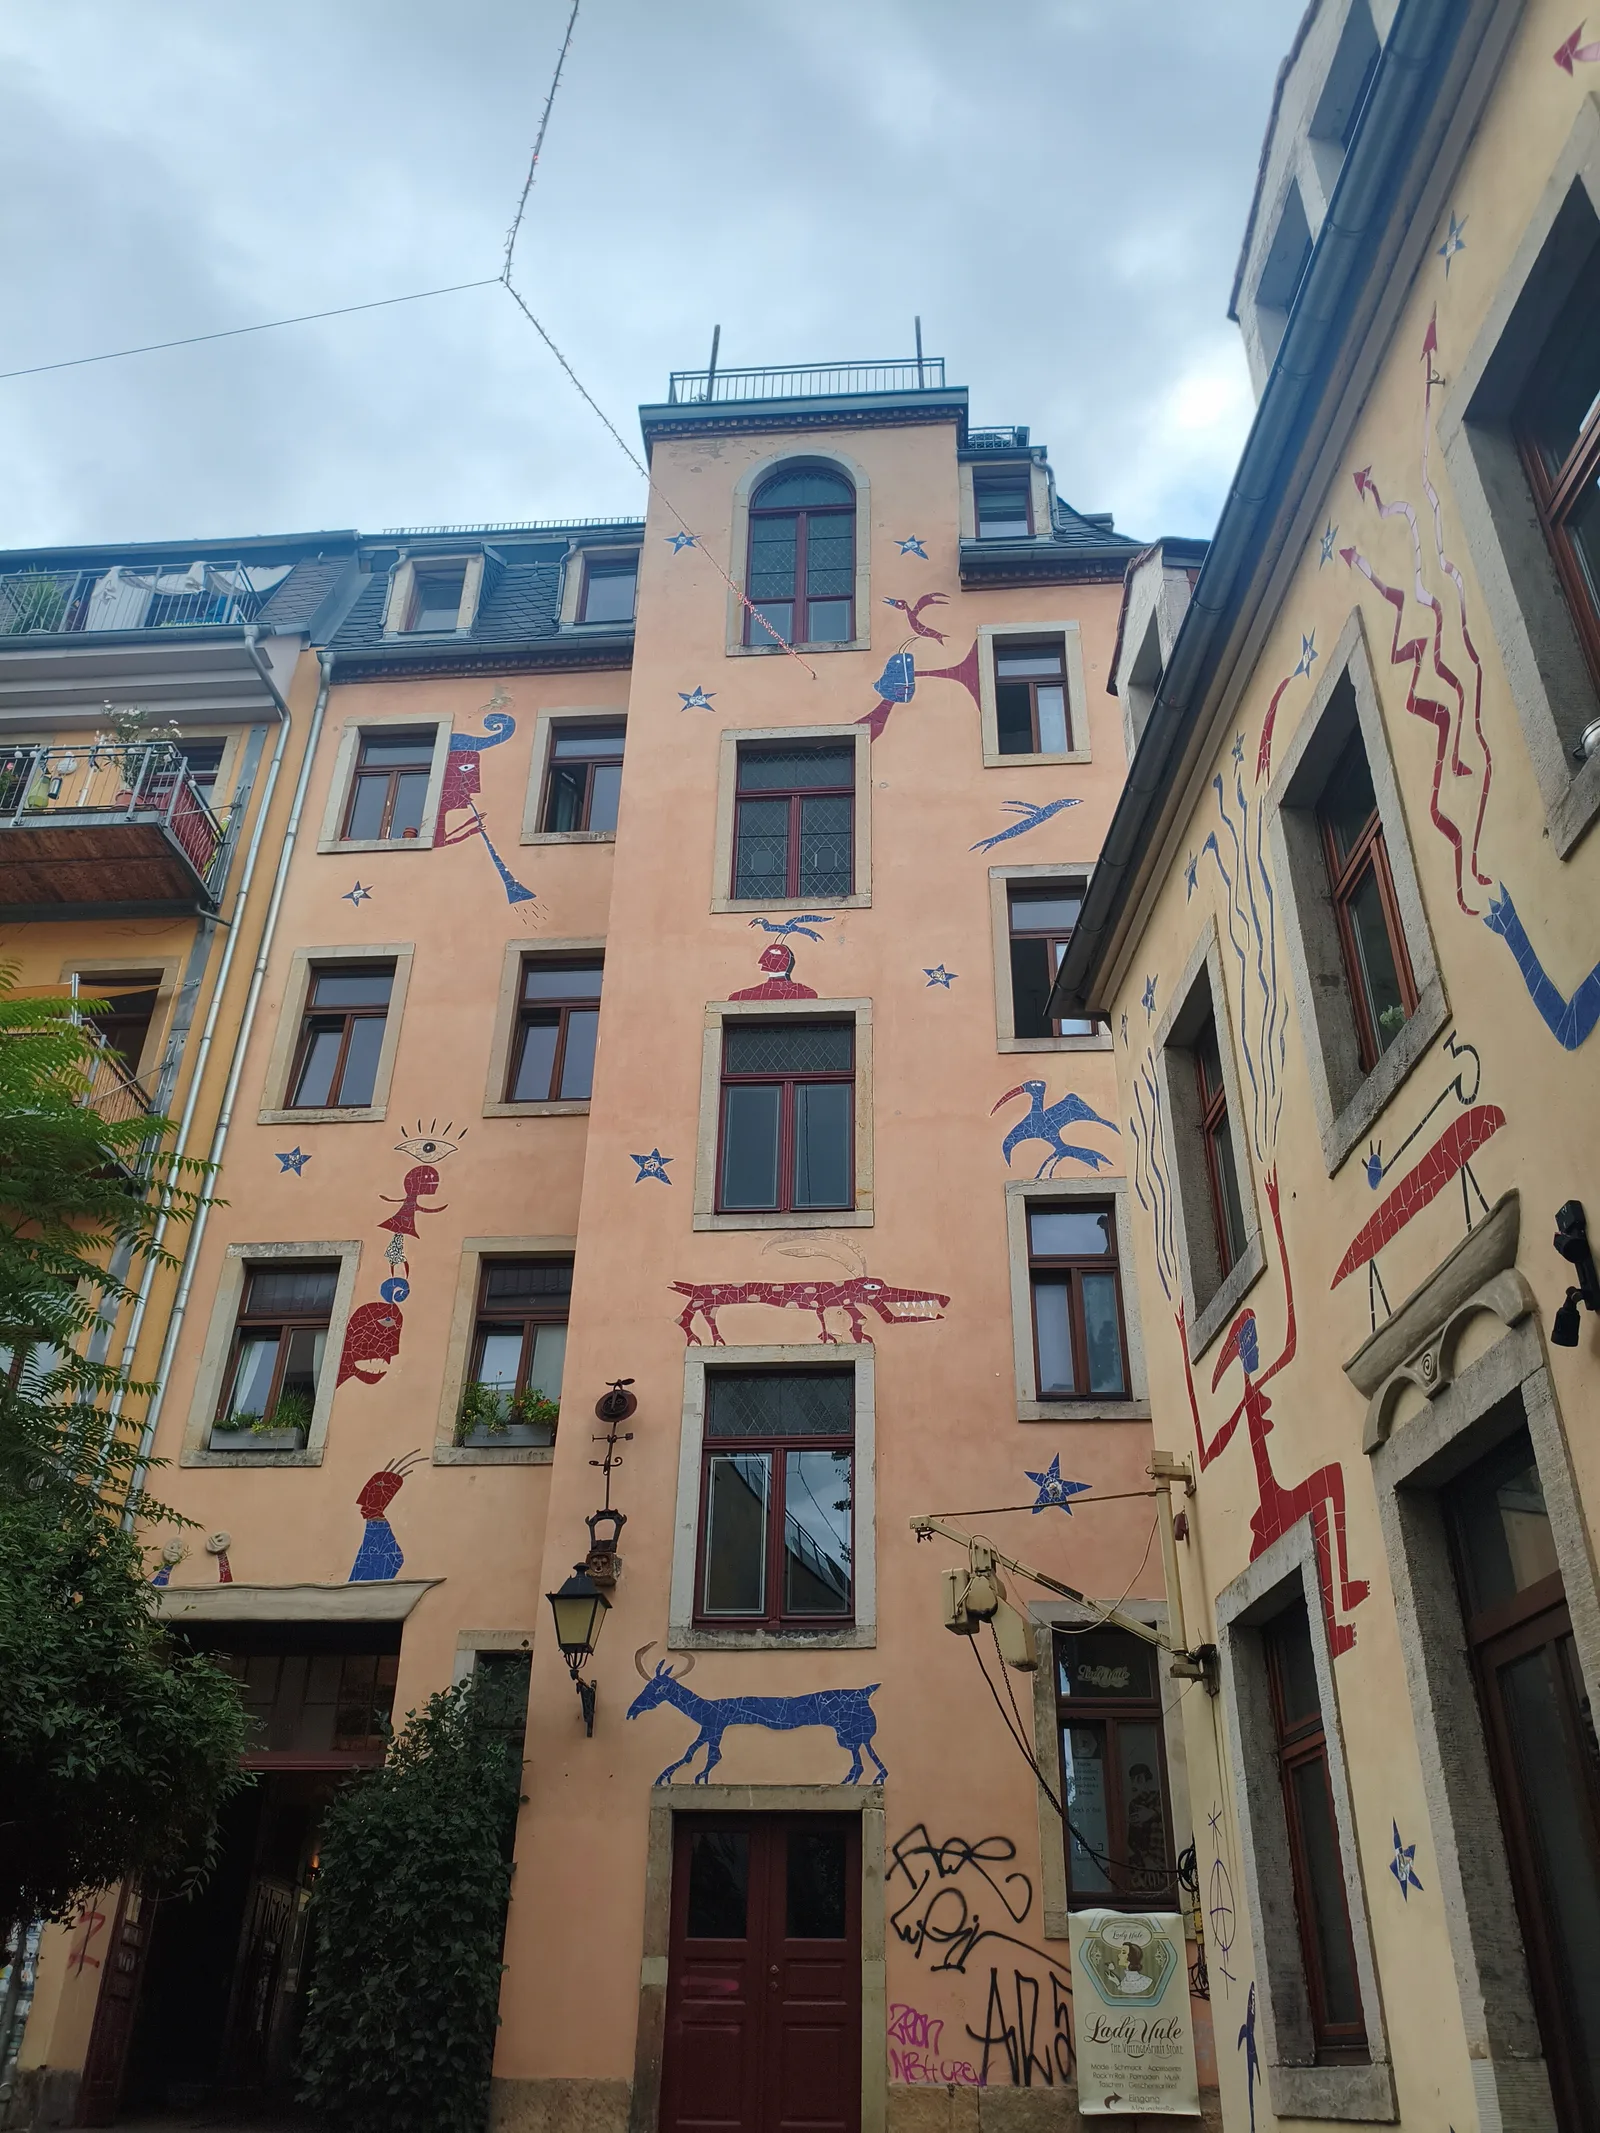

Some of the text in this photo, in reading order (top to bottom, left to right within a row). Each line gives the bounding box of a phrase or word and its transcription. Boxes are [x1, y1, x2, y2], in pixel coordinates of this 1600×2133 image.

[1112, 1930, 1127, 1941] Lady
[1083, 2011, 1185, 2045] Lady Yule
[1110, 2043, 1122, 2053] THE
[1166, 2044, 1184, 2055] STORE
[1128, 2094, 1160, 2104] Eingang
